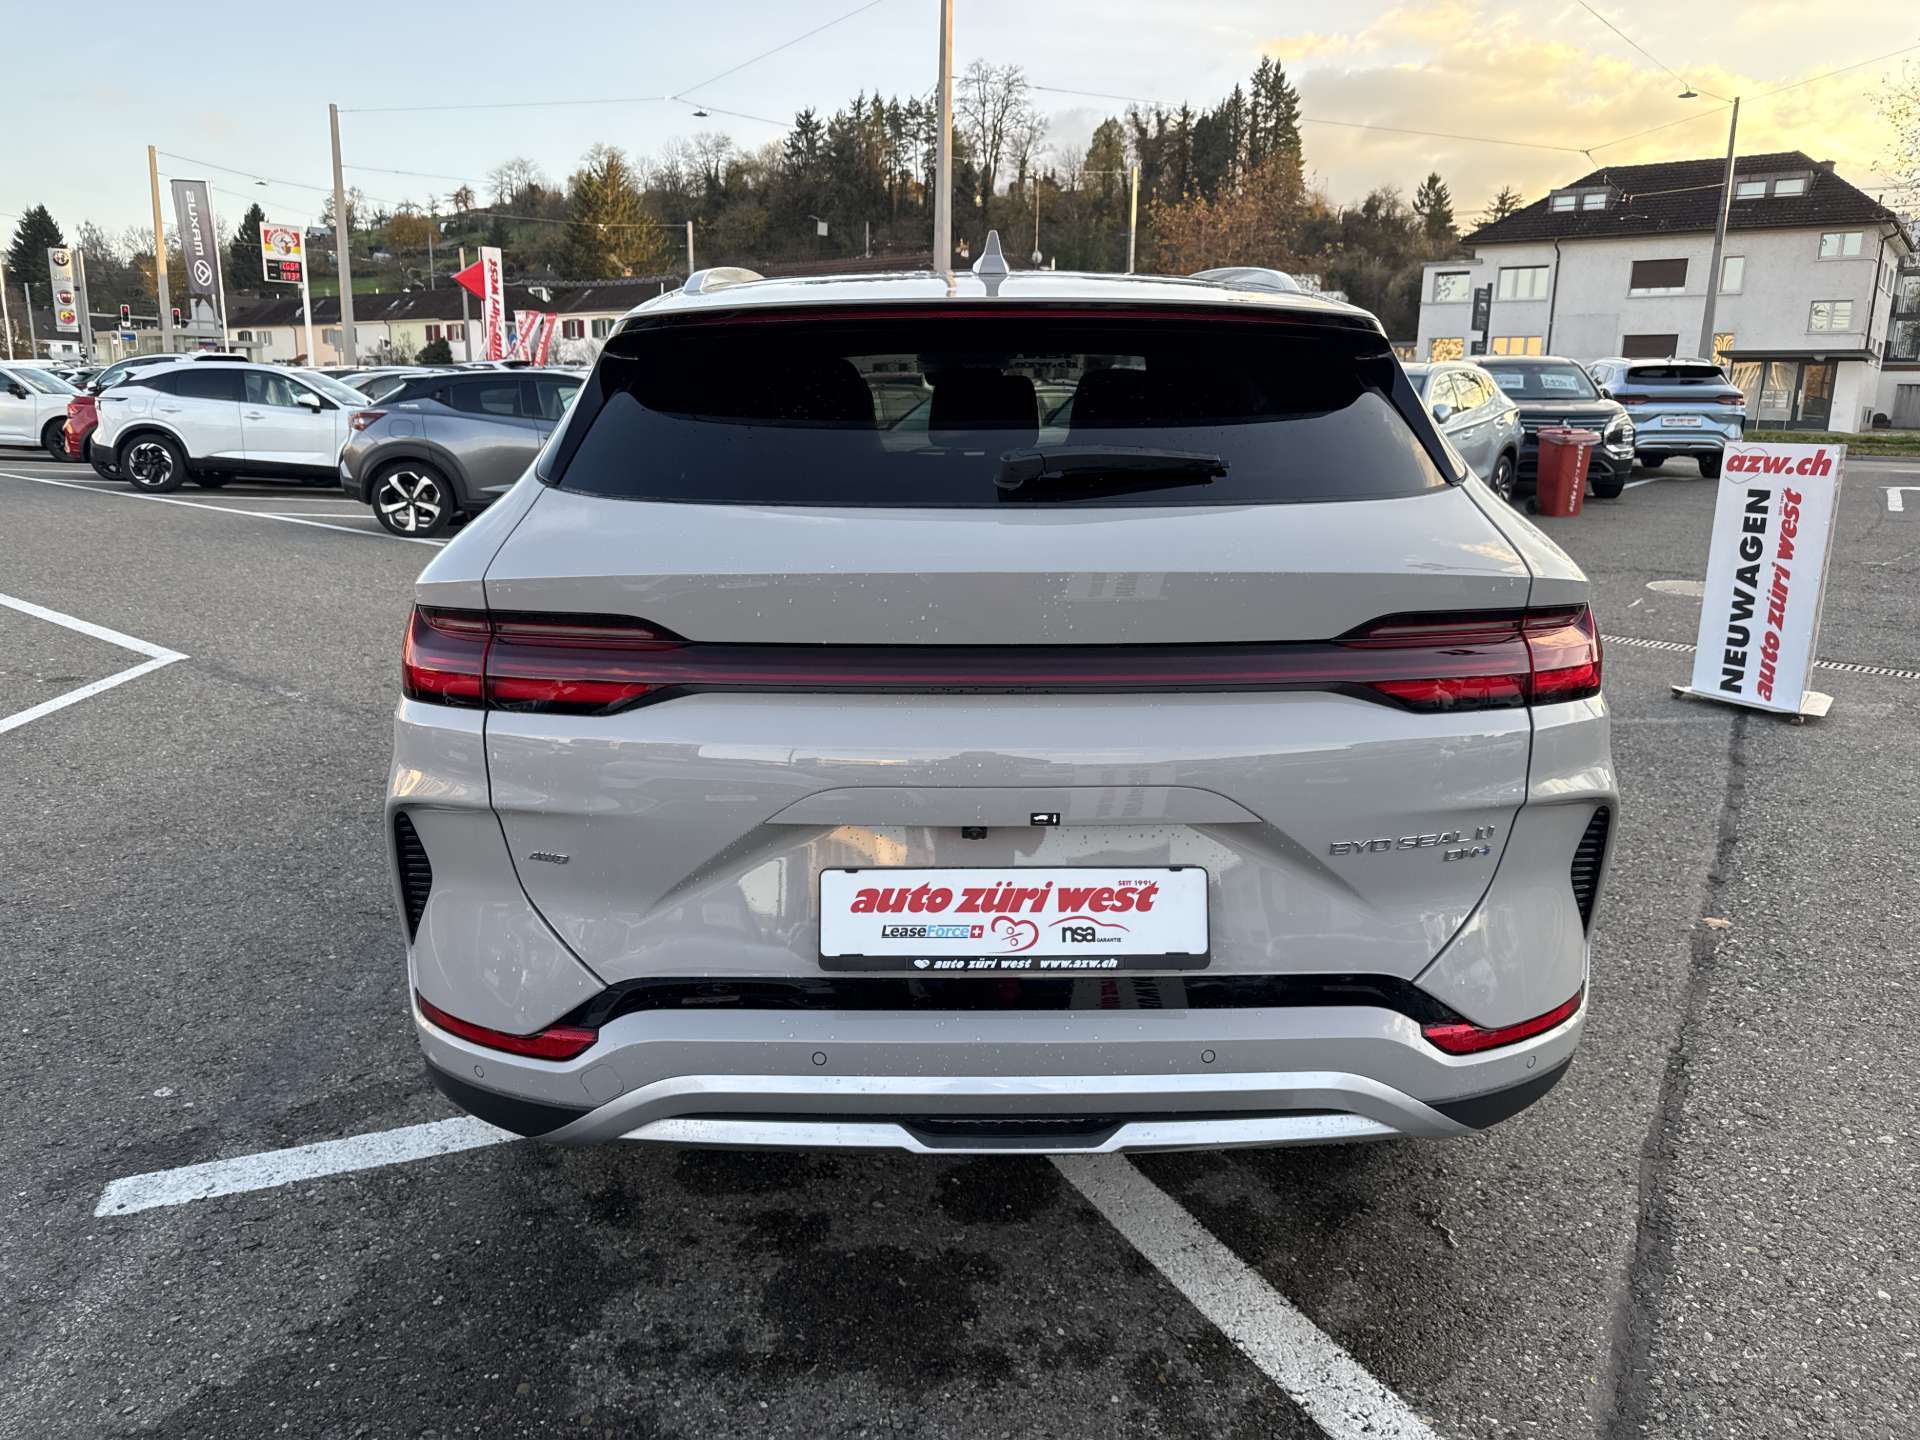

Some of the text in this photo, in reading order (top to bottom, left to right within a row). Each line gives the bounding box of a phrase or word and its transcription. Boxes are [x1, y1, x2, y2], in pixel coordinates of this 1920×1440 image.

[1726, 449, 1832, 477] azw.ch
[1719, 488, 1771, 694] NEUWAGEN
[1757, 487, 1802, 702] auto züri west
[1329, 825, 1495, 856] BYD SEAL U
[850, 880, 1160, 913] auto züri west
[882, 925, 970, 937] LeaseForce
[1062, 926, 1096, 943] nsa
[934, 957, 1118, 969] auto züri west www.azw.ch
